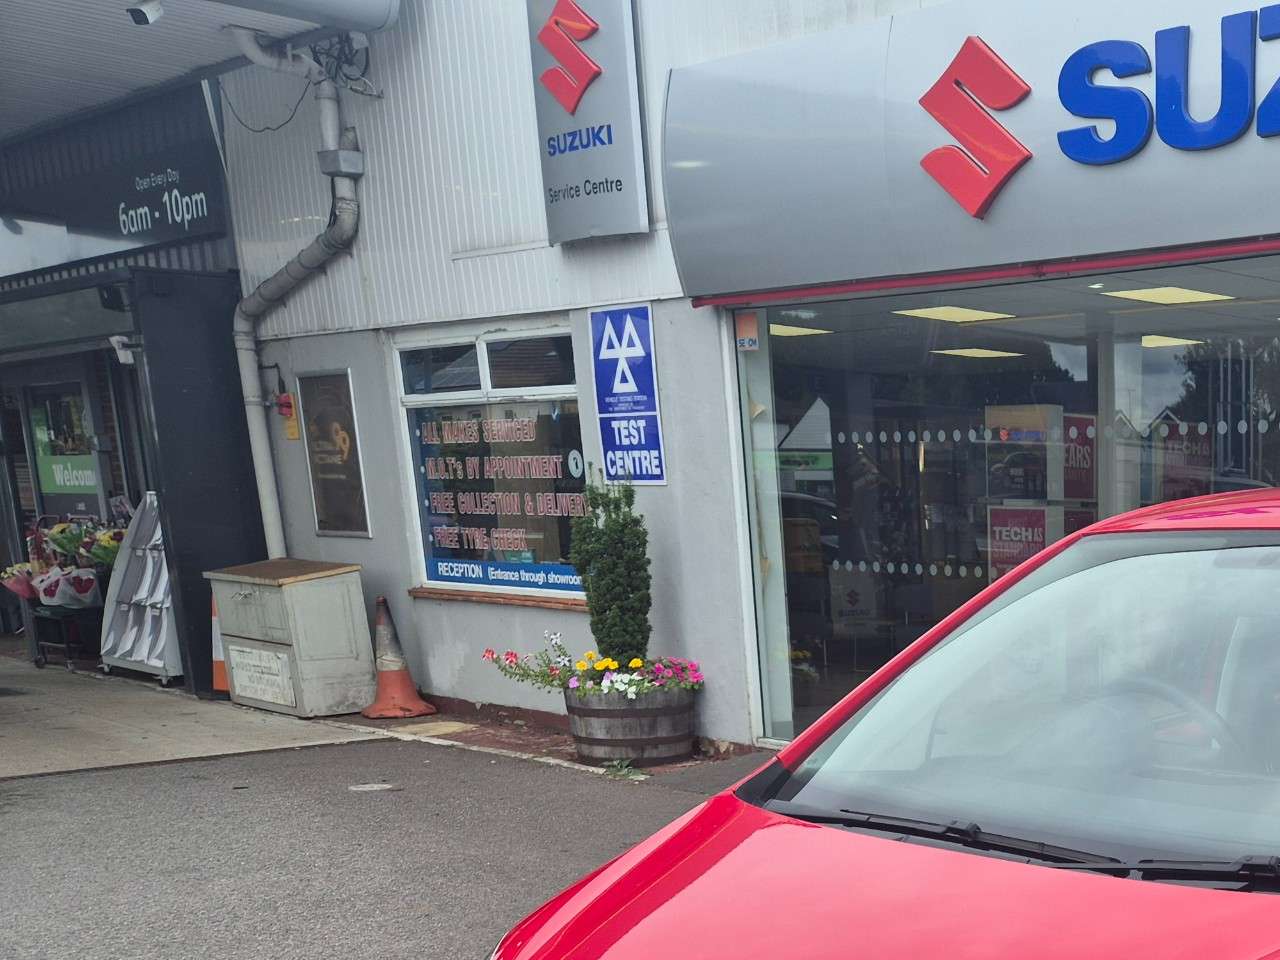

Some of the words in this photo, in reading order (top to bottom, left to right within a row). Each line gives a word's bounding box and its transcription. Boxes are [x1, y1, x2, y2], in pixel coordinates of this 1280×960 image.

[547, 124, 613, 157] SUZUKI
[548, 184, 581, 204] Service
[583, 177, 623, 196] Centre
[119, 202, 152, 235] 6am
[162, 188, 208, 231] 10pm
[422, 422, 440, 444] ALL
[442, 420, 479, 444] MAKES
[482, 418, 537, 443] SERVICED
[611, 419, 646, 446] TEST
[52, 463, 97, 486] Welcom
[465, 457, 480, 479] BY
[484, 455, 563, 479] APPOINTMENT
[606, 450, 662, 476] CENTRE
[429, 492, 456, 514] FREE
[458, 492, 521, 515] COLLECTION
[525, 492, 534, 516] &
[433, 527, 460, 549] FREE
[463, 527, 490, 550] TYRE
[491, 528, 528, 551] CHECK
[993, 526, 1032, 542] TECH
[438, 562, 483, 578] RECEPTION
[488, 566, 520, 581] (Entrance
[520, 569, 546, 585] through
